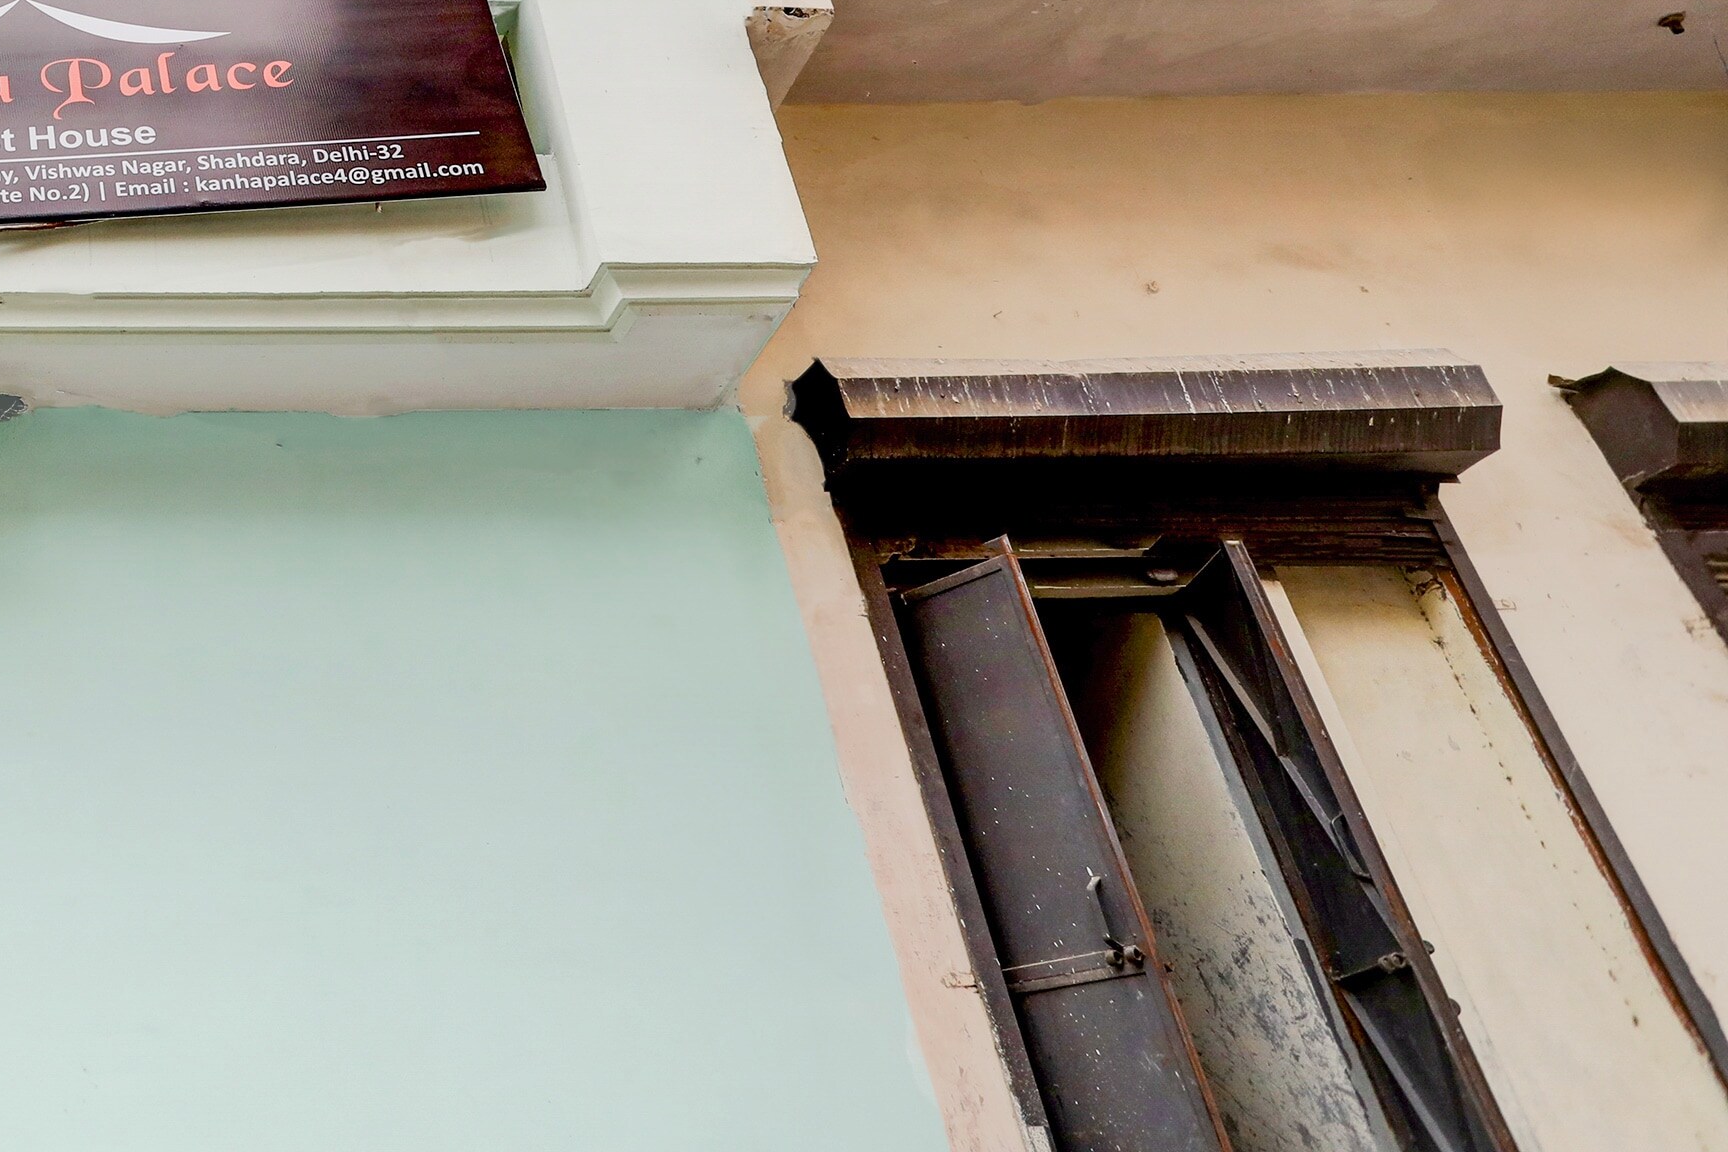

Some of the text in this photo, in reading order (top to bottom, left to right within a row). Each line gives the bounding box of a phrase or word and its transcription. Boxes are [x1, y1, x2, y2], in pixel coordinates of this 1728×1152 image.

[40, 52, 294, 120] Palace
[28, 125, 157, 150] House
[24, 162, 115, 181] Vishwas
[122, 159, 192, 176] Nagar,
[197, 151, 307, 171] Shahdara,
[312, 144, 404, 164] Delhi-32
[29, 184, 90, 202] No.2)
[115, 178, 176, 197] Email
[195, 162, 485, 192] kanhapalace4@gmail.com
